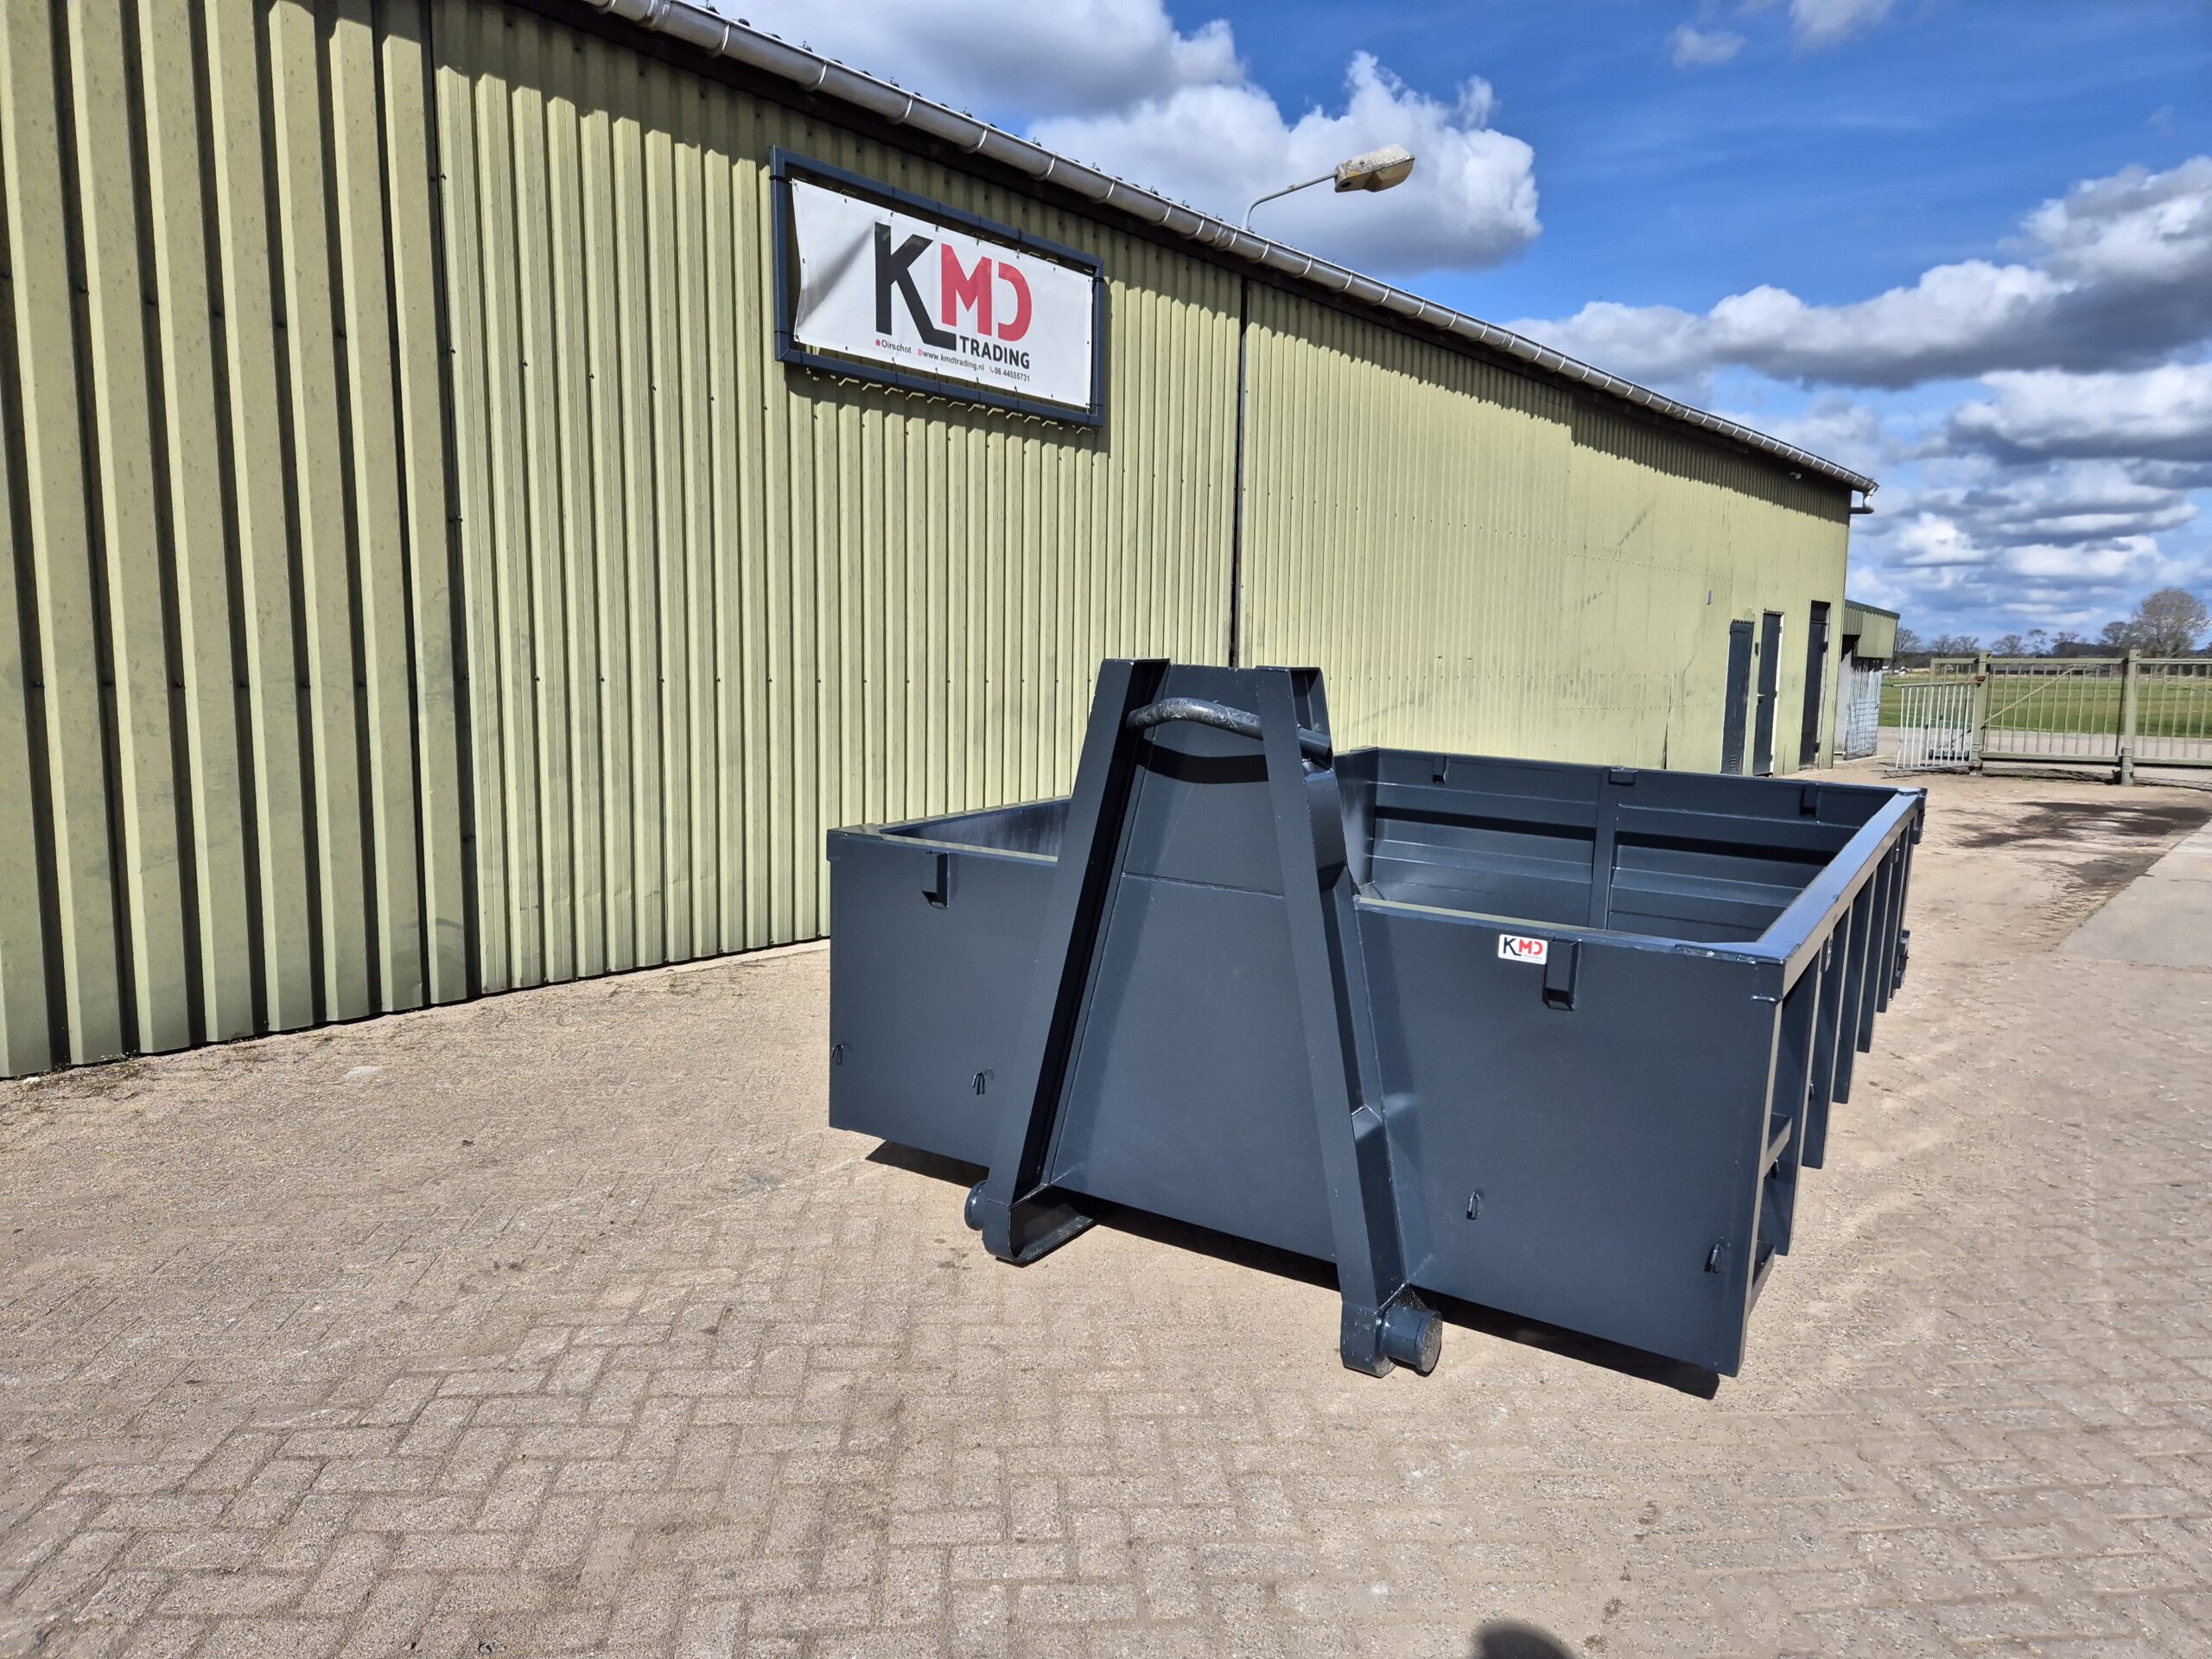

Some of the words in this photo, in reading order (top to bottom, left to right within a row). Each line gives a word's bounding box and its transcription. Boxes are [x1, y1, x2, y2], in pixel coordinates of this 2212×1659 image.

[874, 222, 1032, 351] KMD
[881, 340, 912, 353] Oirschot
[923, 352, 984, 371] www.kmdtrading.nl
[995, 366, 1001, 375] 06
[959, 335, 1030, 369] TRADING
[1503, 937, 1543, 956] KMD
